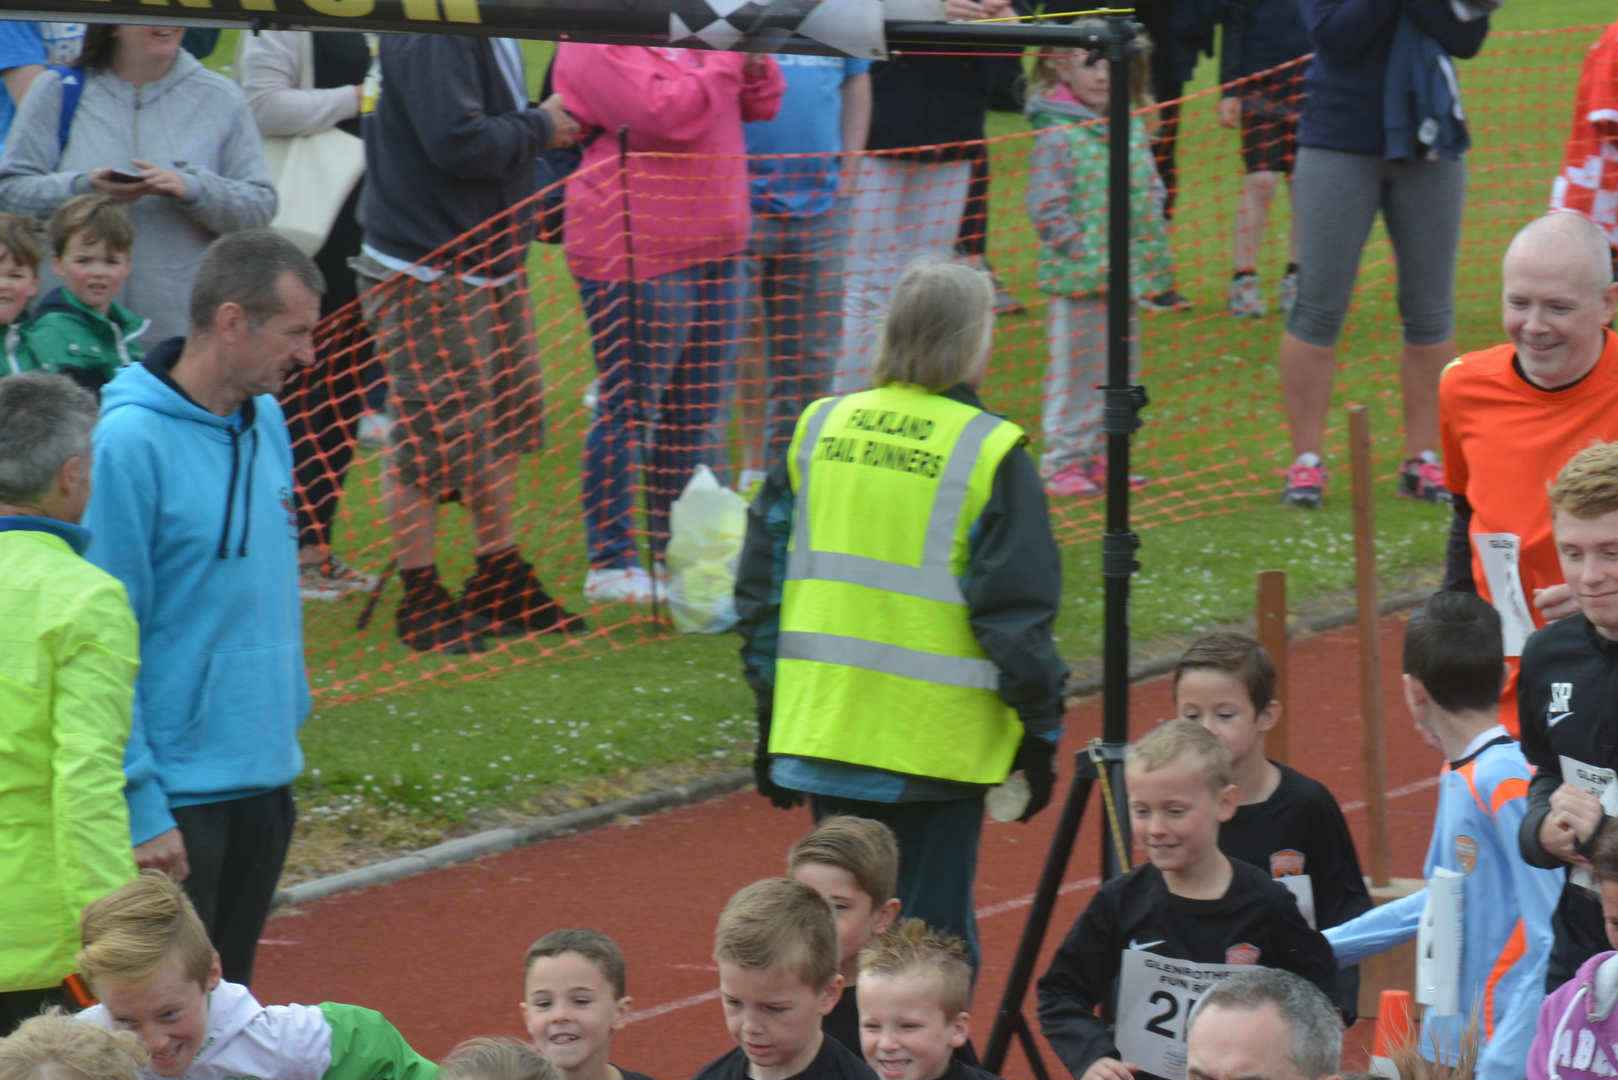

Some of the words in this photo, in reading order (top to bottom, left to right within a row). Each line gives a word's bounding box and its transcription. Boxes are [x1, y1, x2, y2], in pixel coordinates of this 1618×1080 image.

[844, 408, 935, 441] FALKLAND
[815, 436, 858, 464] TRAIL
[858, 440, 945, 479] RUNNERS
[1159, 974, 1190, 990] FUN
